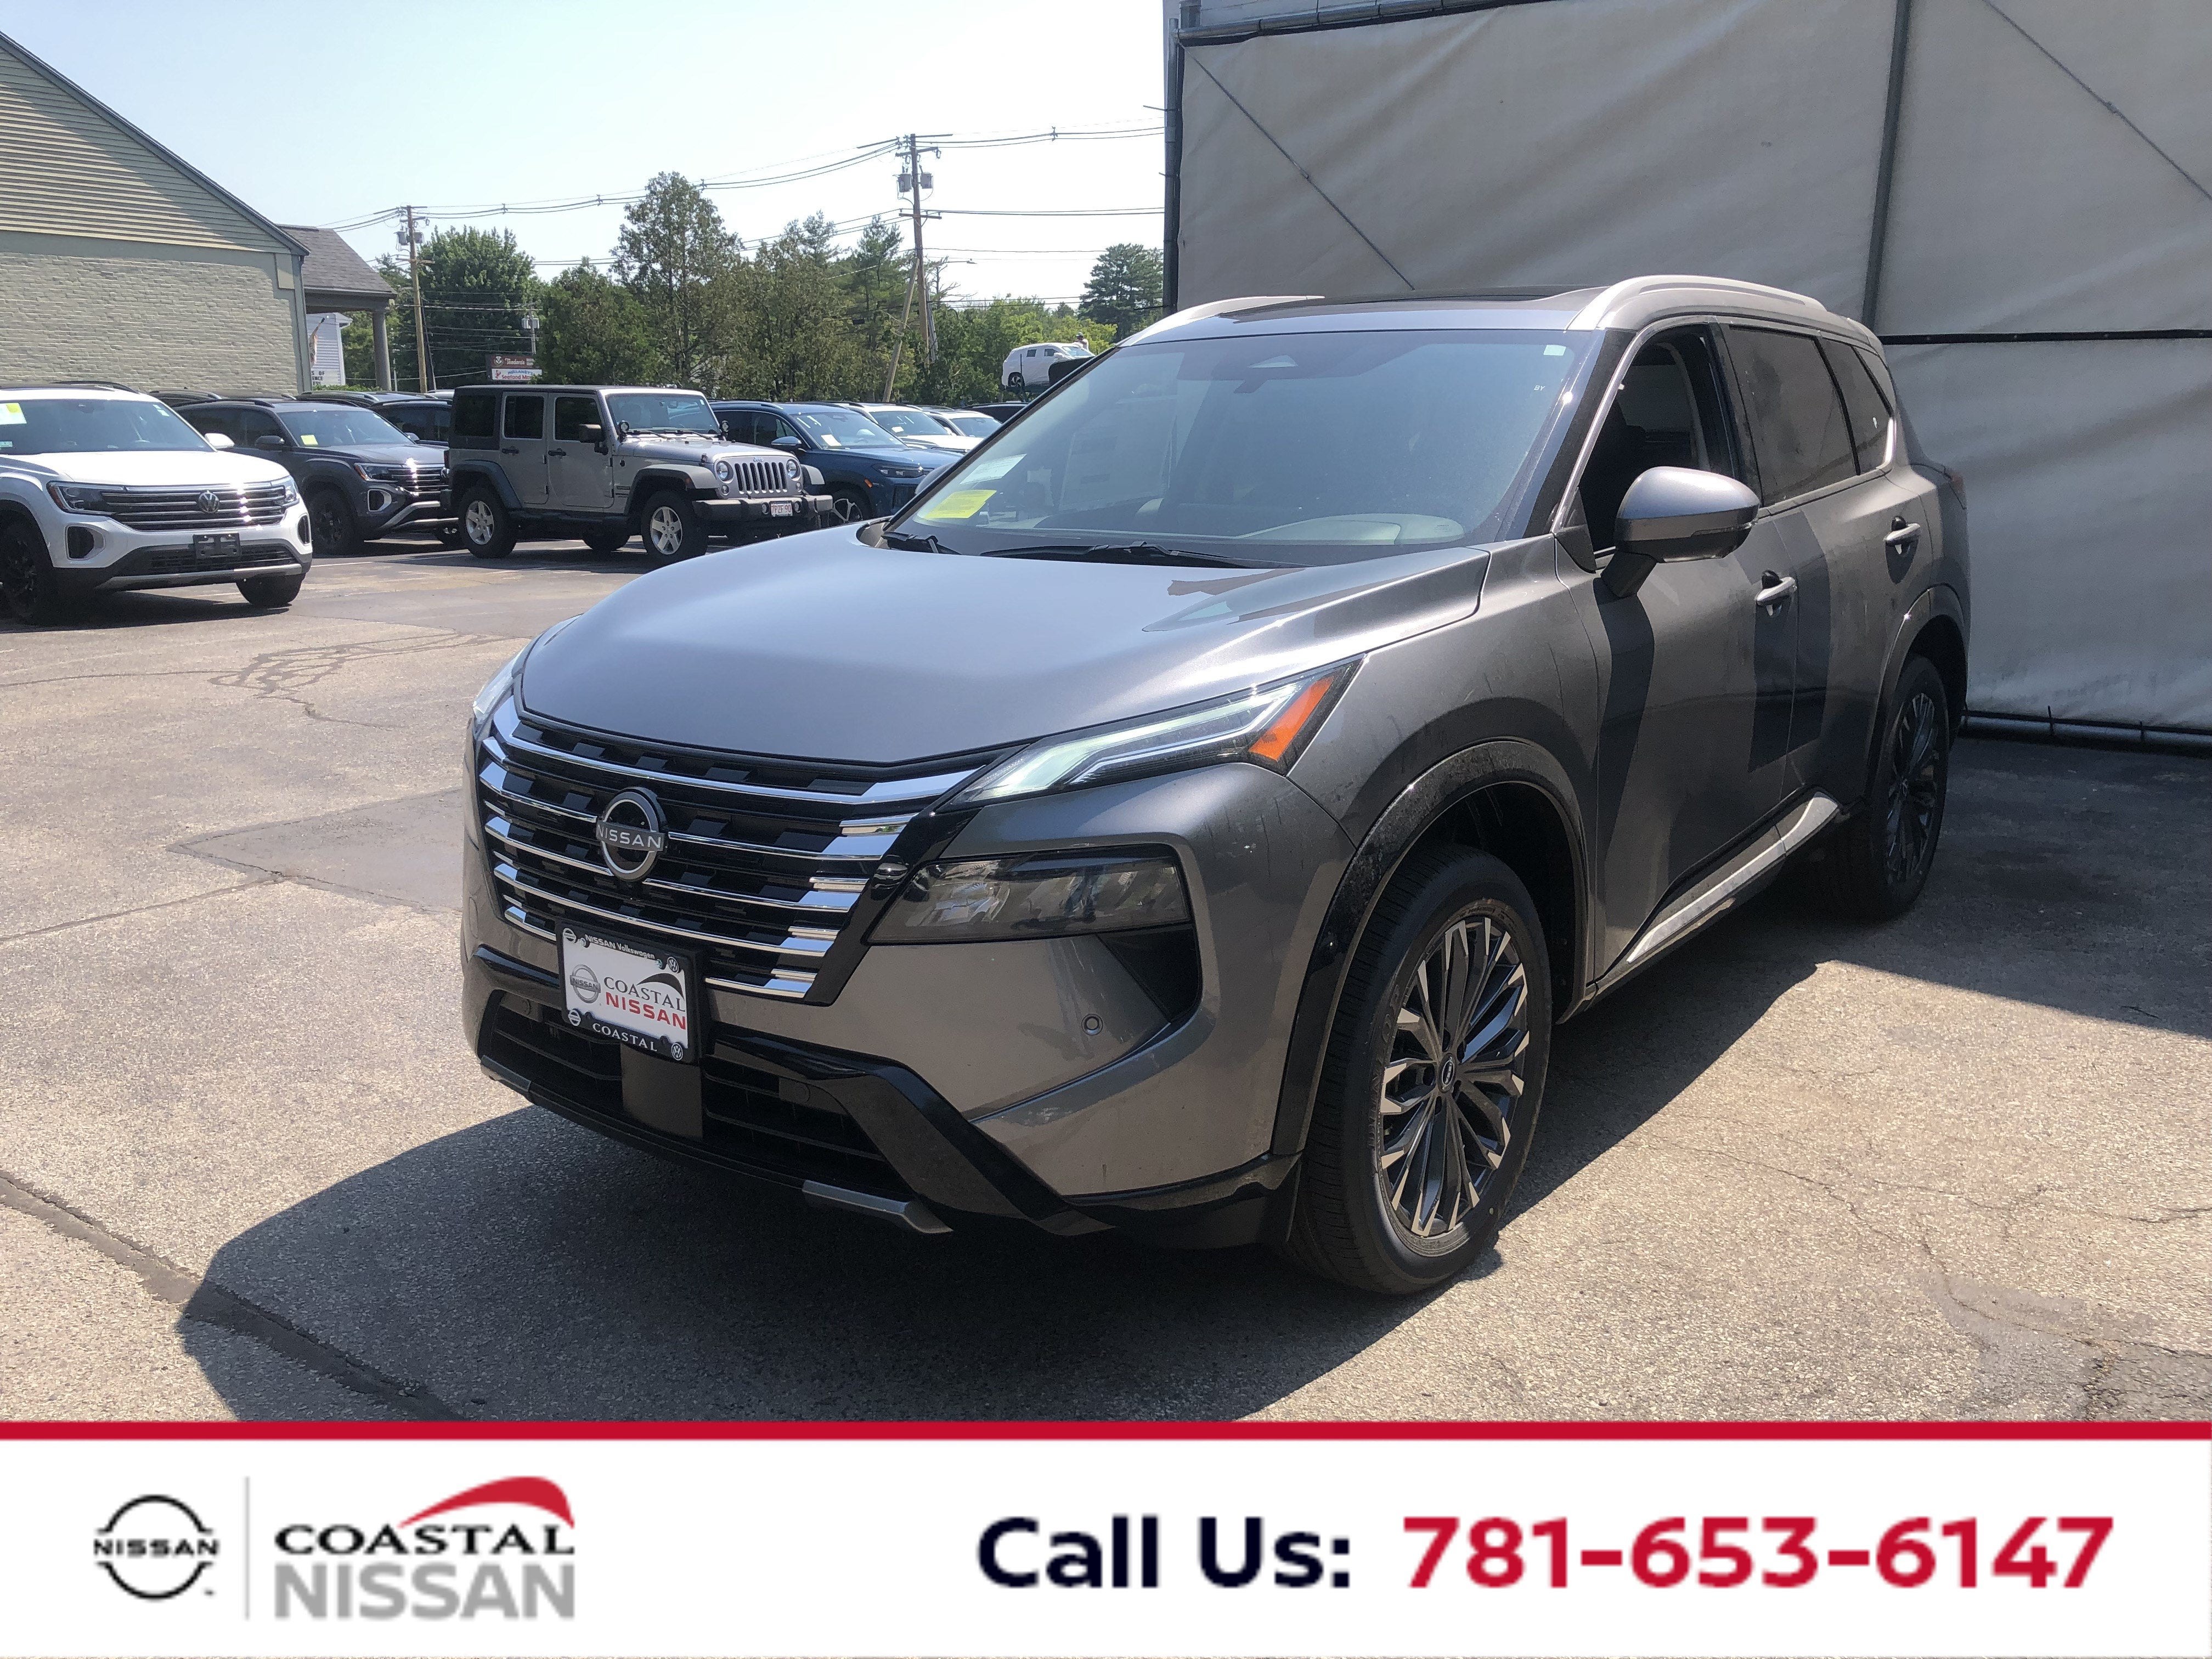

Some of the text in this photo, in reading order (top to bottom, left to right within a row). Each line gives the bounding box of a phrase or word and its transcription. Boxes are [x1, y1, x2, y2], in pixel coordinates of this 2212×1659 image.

[597, 824, 662, 849] NISSAN
[585, 934, 655, 959] NISSAN Volkswagen
[572, 978, 599, 989] NISSAN
[604, 977, 686, 1013] COASTAL
[606, 991, 686, 1030] NISSAN
[592, 1022, 658, 1052] COASTAL
